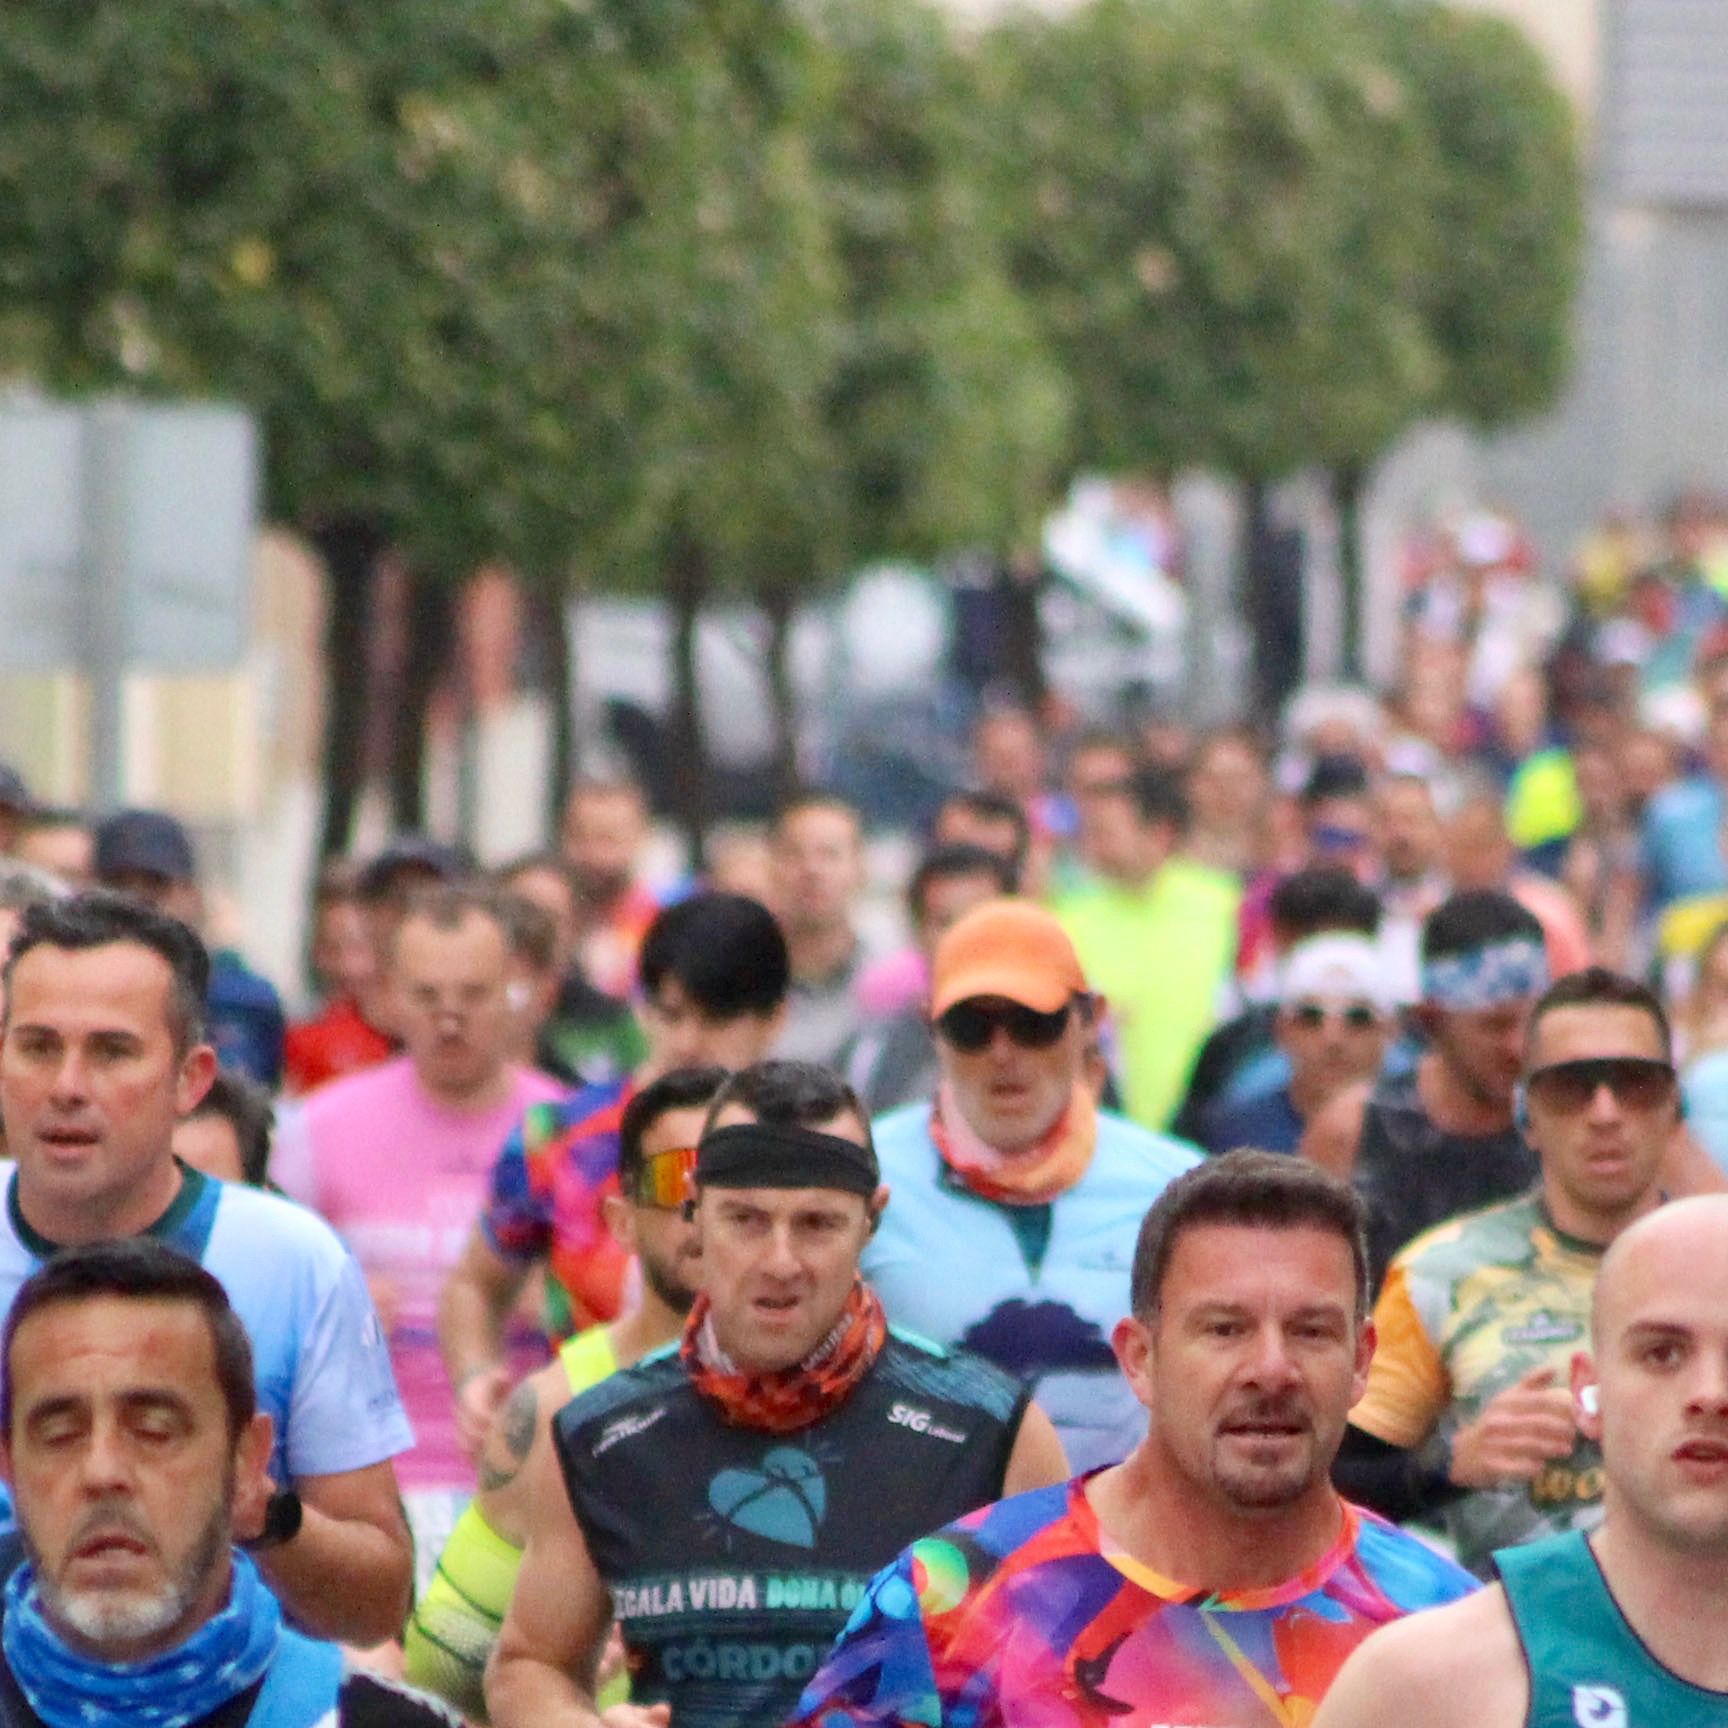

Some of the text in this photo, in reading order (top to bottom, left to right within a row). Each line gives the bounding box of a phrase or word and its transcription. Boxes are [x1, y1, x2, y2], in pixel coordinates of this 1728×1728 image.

[885, 1401, 933, 1433] SIG
[688, 1577, 757, 1611] VIDA
[661, 1633, 824, 1681] CÓRDO
